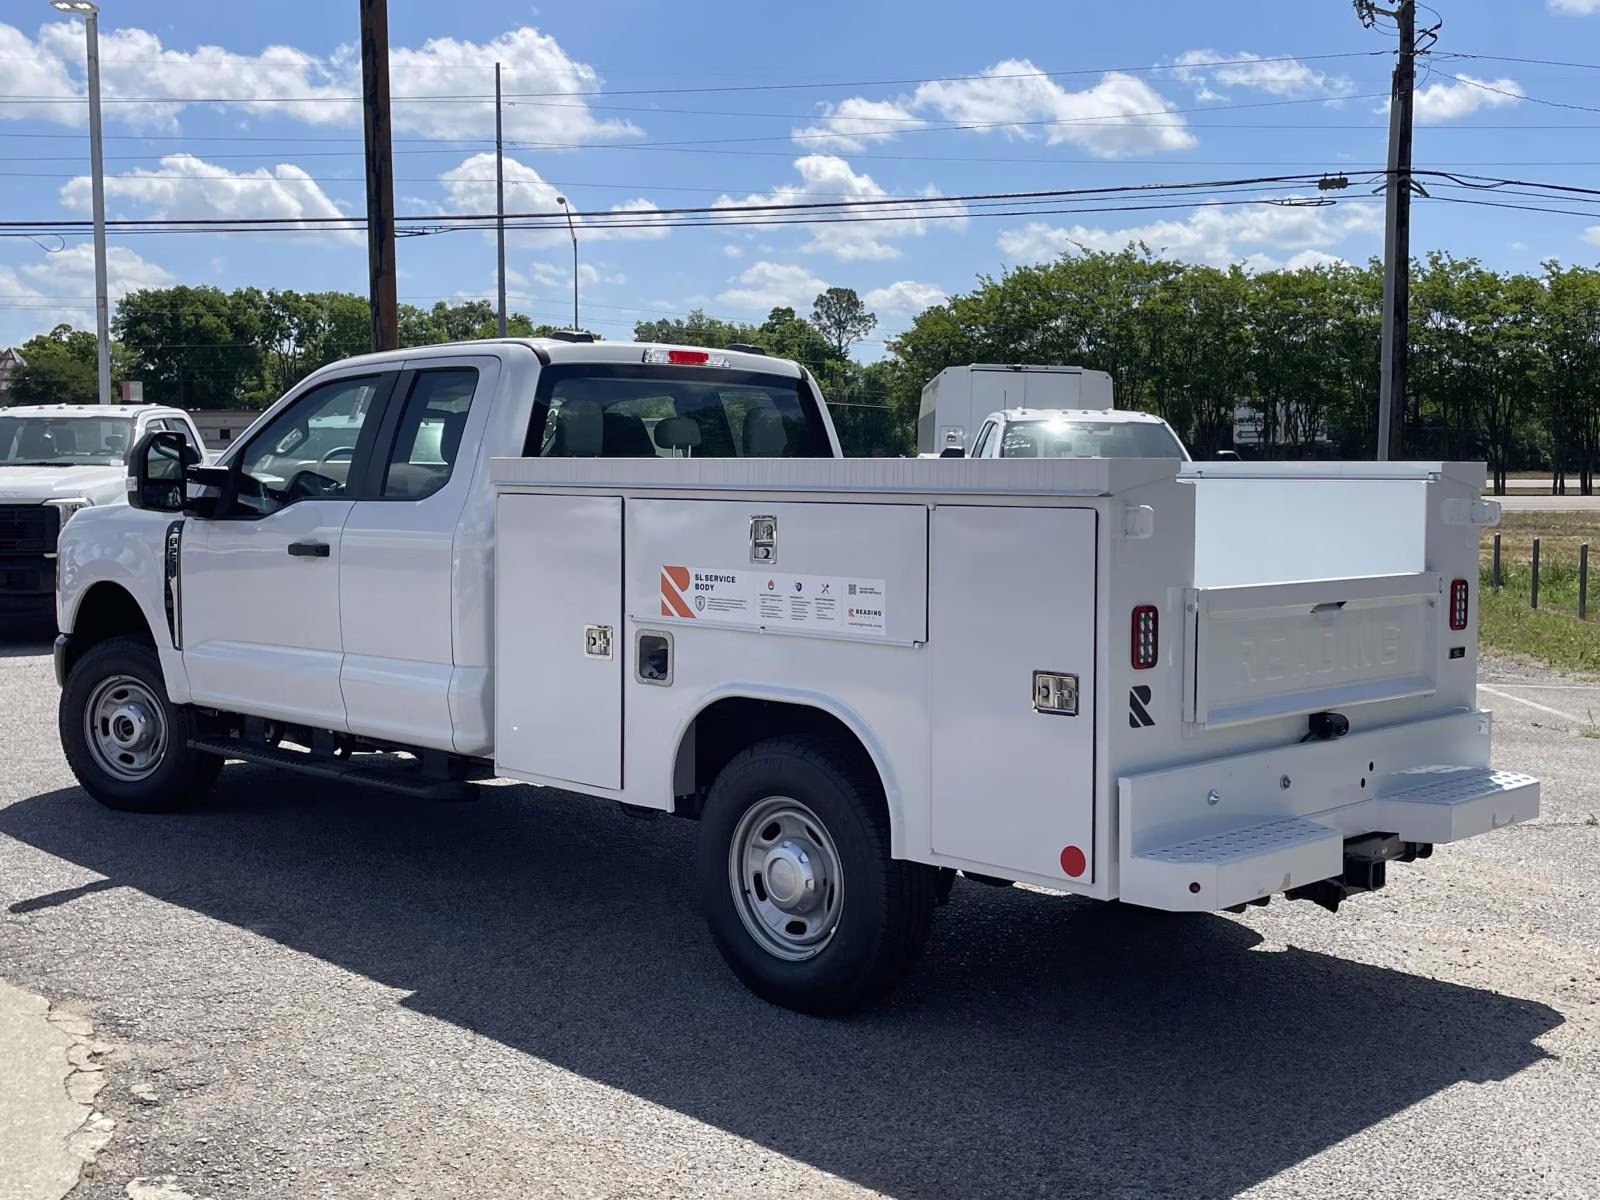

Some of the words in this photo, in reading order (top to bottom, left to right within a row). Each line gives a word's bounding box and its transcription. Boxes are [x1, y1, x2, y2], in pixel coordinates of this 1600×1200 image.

[705, 575, 736, 583] SERVICE
[695, 583, 714, 591] BODY
[1233, 622, 1401, 684] READING
